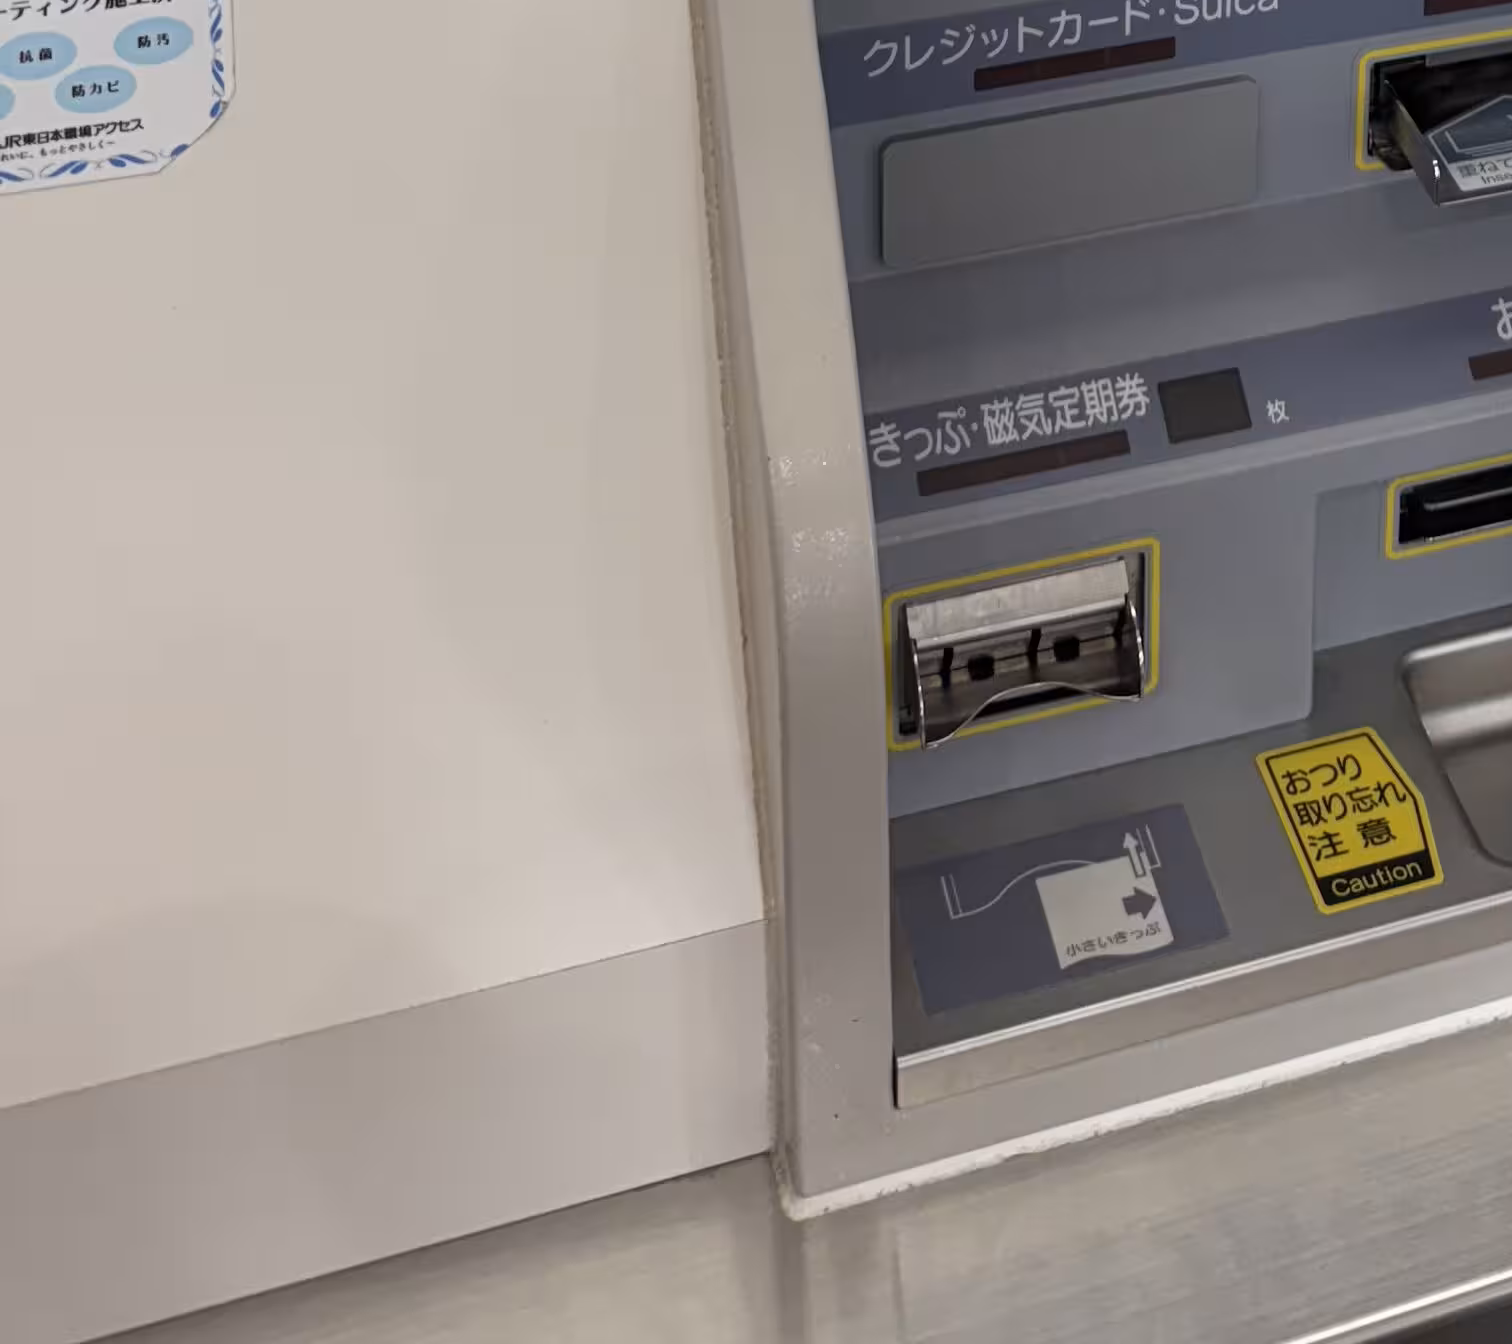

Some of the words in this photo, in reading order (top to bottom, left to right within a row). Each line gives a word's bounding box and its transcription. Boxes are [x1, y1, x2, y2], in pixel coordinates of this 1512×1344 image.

[1266, 399, 1290, 424] 枚
[1281, 753, 1363, 796] おつり
[1293, 780, 1407, 824] 取り忘れ
[1309, 819, 1398, 862] 注意
[1330, 860, 1423, 898] Caution
[1066, 920, 1163, 958] 小さいきっぷ
